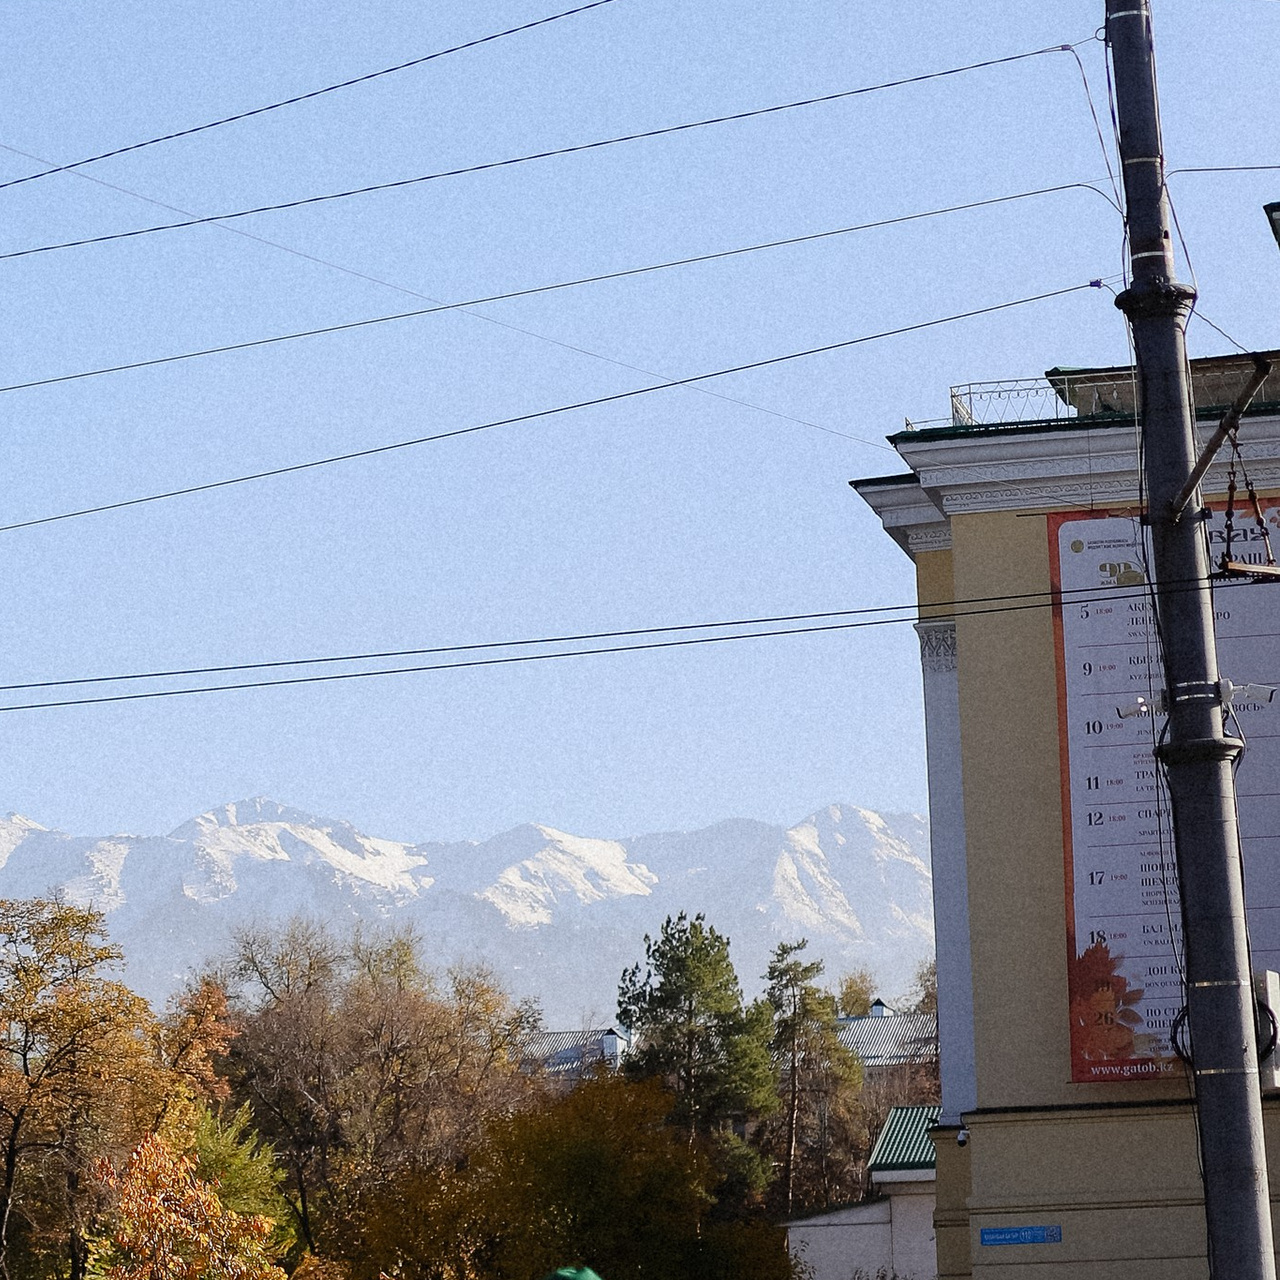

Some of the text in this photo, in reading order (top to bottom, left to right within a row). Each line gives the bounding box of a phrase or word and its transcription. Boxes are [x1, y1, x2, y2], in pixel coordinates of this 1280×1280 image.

[1080, 603, 1090, 620] 5
[1082, 662, 1117, 676] 9 19:00
[1084, 720, 1124, 735] 10 19:00
[1086, 776, 1124, 790] 11 18:00
[1086, 811, 1104, 826] 12
[1088, 871, 1128, 886] 17 19:00
[1089, 930, 1127, 944] 18 18:00
[1093, 1011, 1114, 1026] 26
[1090, 1062, 1174, 1077] www.gatob.kz
